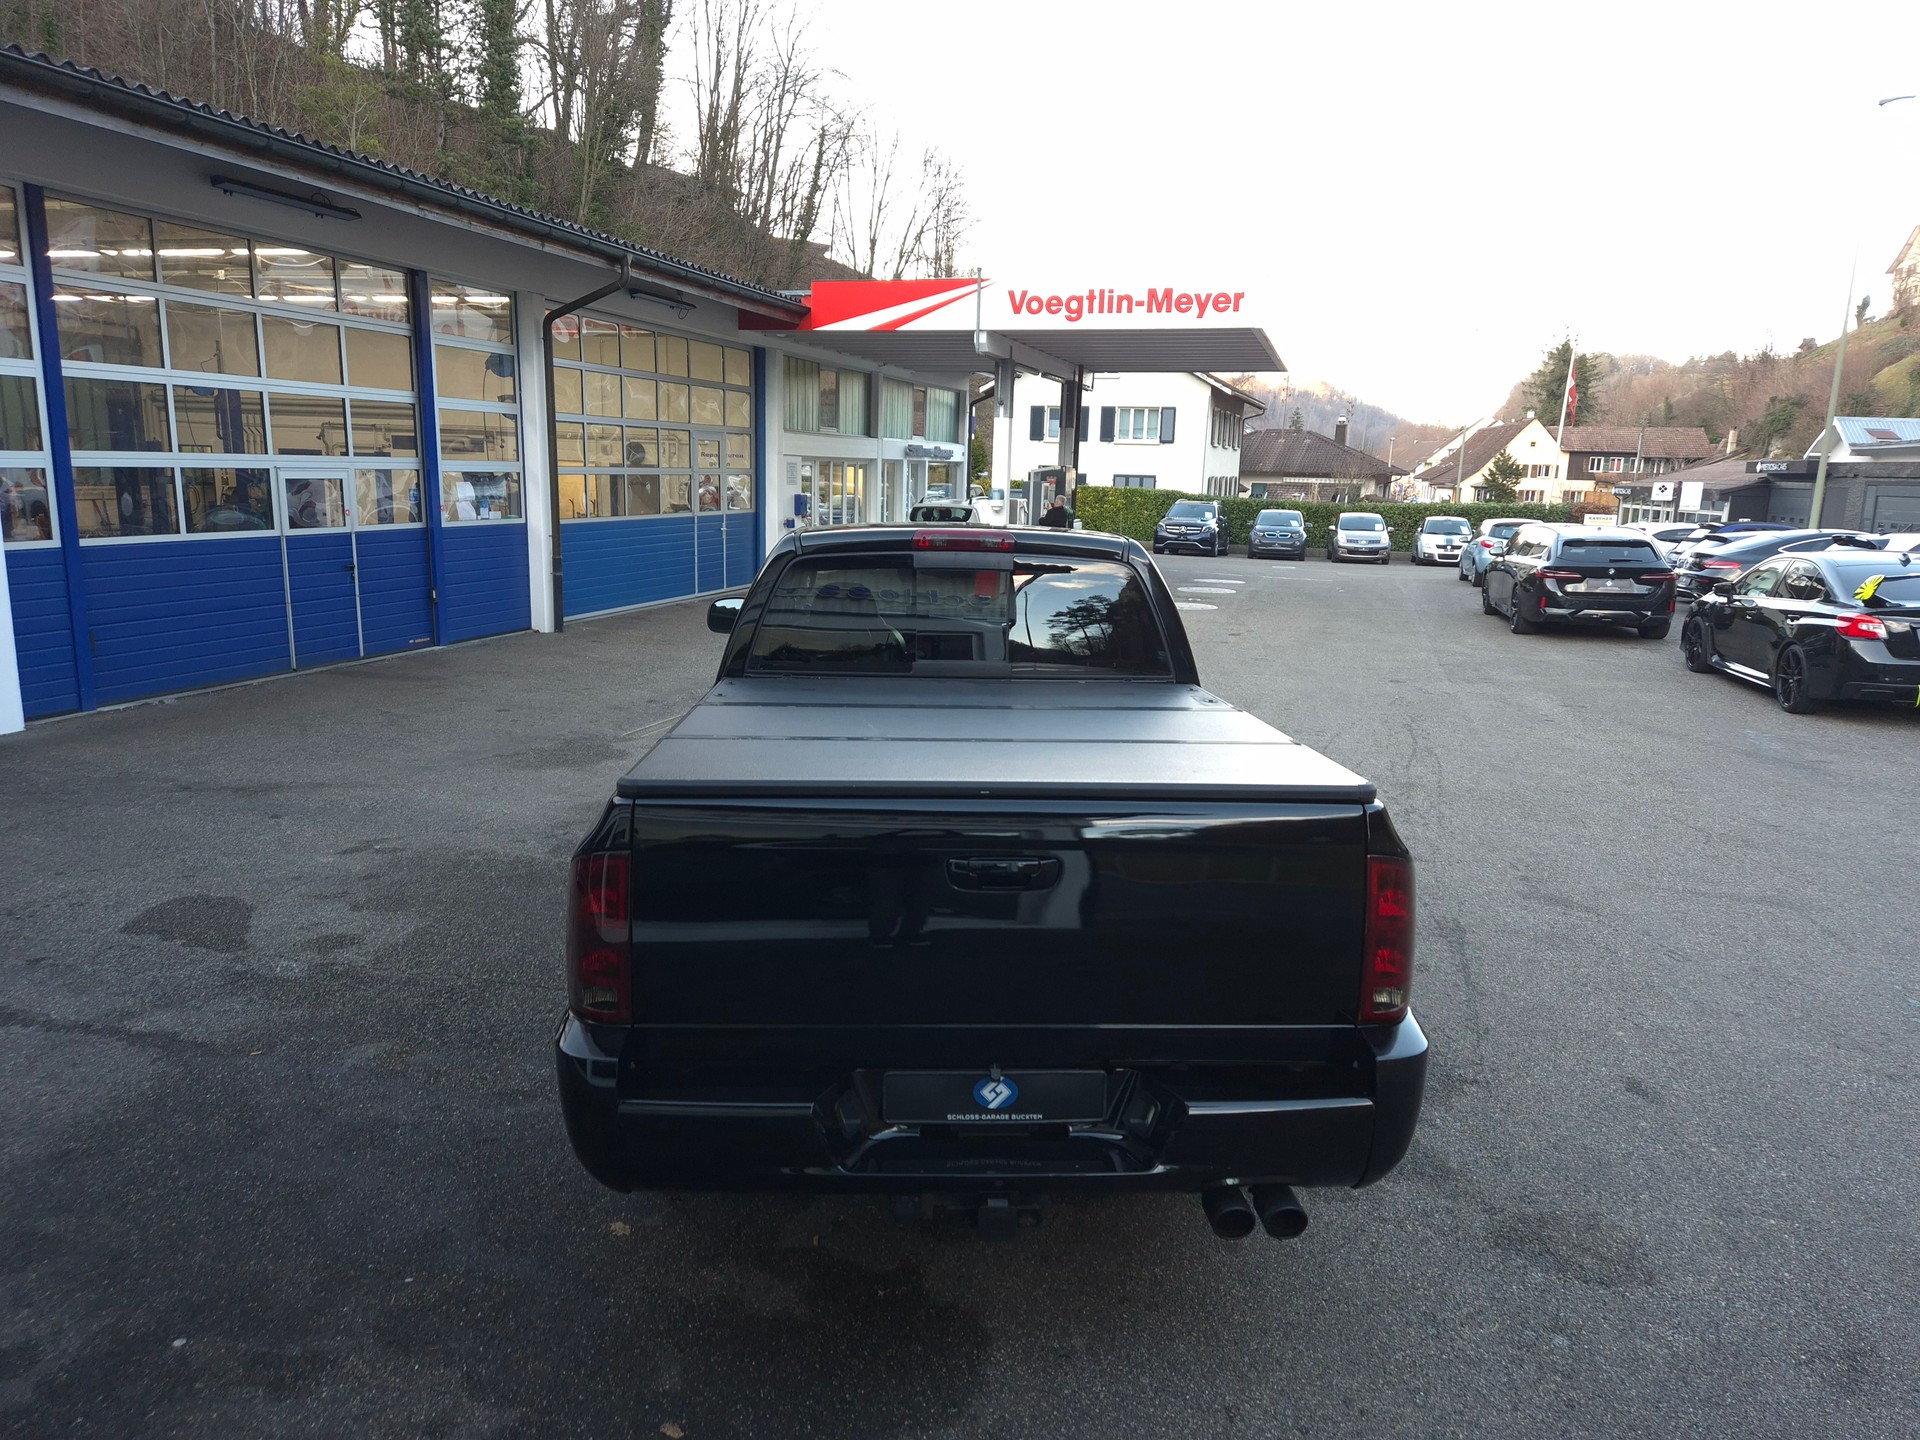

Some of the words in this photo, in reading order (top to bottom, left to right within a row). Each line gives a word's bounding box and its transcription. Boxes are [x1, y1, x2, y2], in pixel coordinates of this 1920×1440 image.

[1008, 287, 1245, 322] Voegtlin-Meyer
[700, 451, 744, 459] Repauren
[947, 1113, 1010, 1121] SCHLOSS-GARAGE
[1011, 1113, 1043, 1121] BUCKTEN
